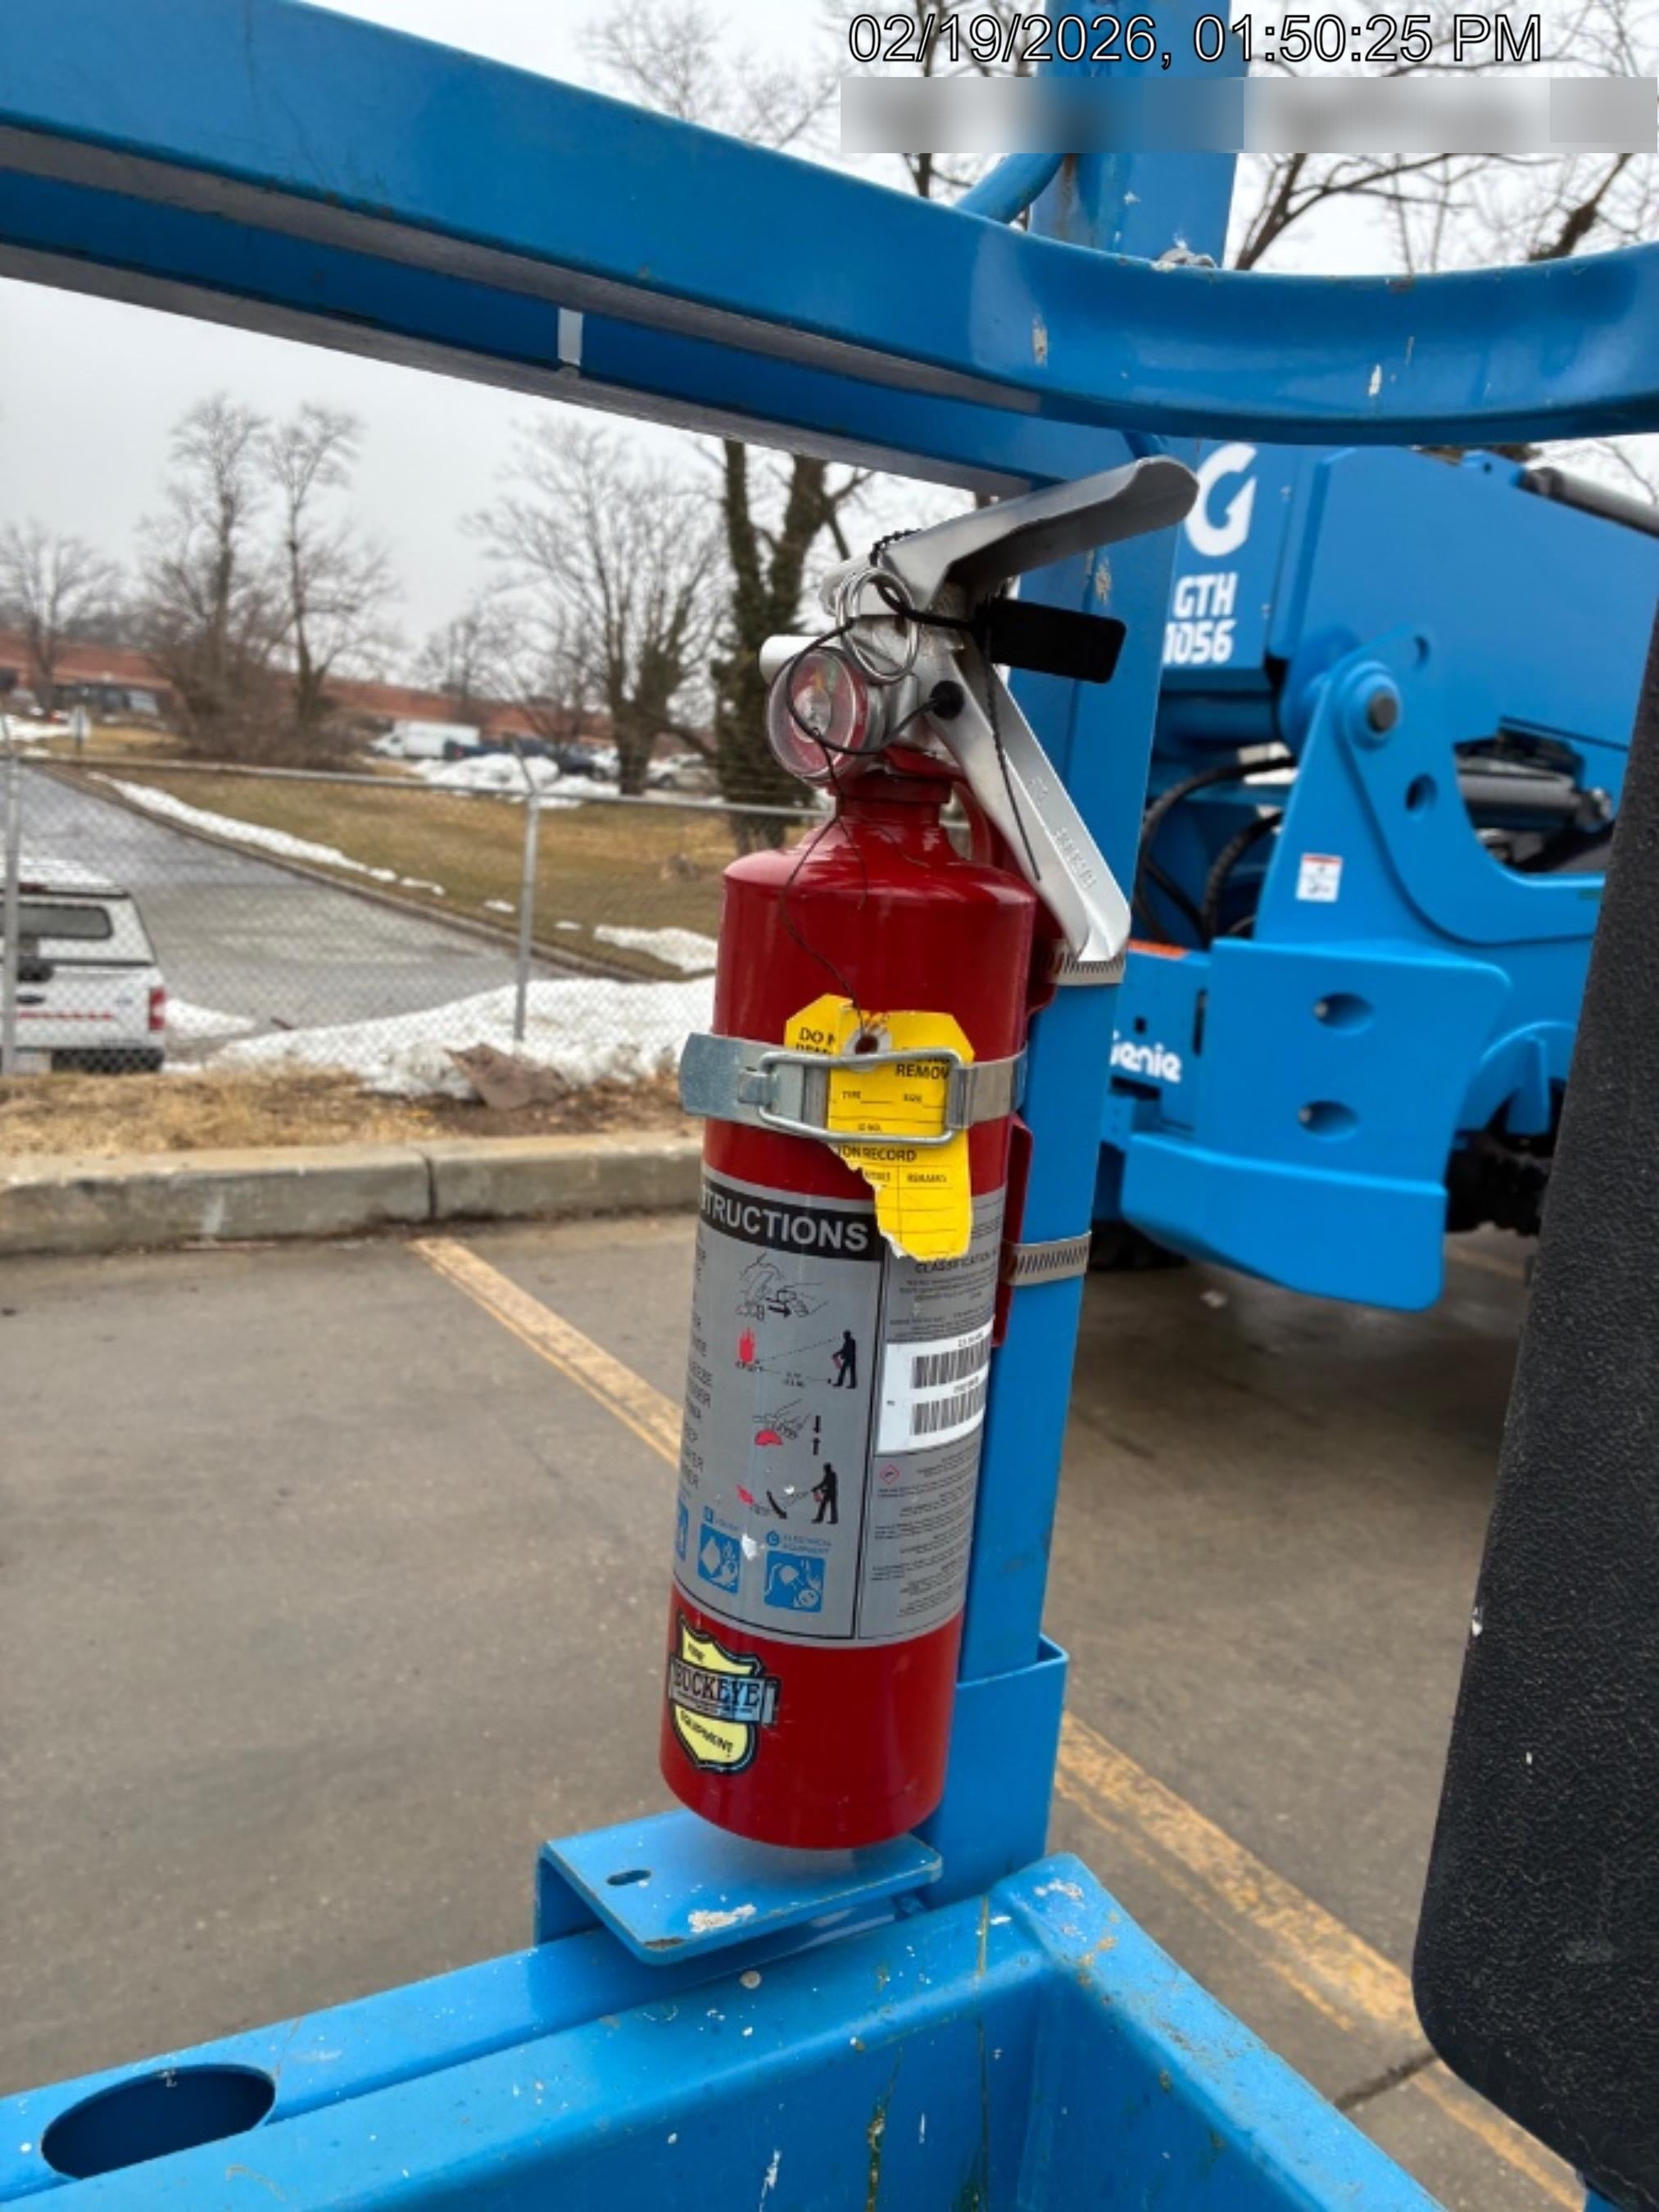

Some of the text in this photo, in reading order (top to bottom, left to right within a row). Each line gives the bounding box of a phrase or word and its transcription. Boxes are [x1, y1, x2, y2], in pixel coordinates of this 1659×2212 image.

[1173, 573, 1239, 618] GTH
[1163, 619, 1237, 665] 1056
[799, 1027, 824, 1044] DO
[895, 1063, 950, 1080] REMOV
[862, 1147, 918, 1163] RECORD
[700, 1185, 869, 1253] TRUCTIONS
